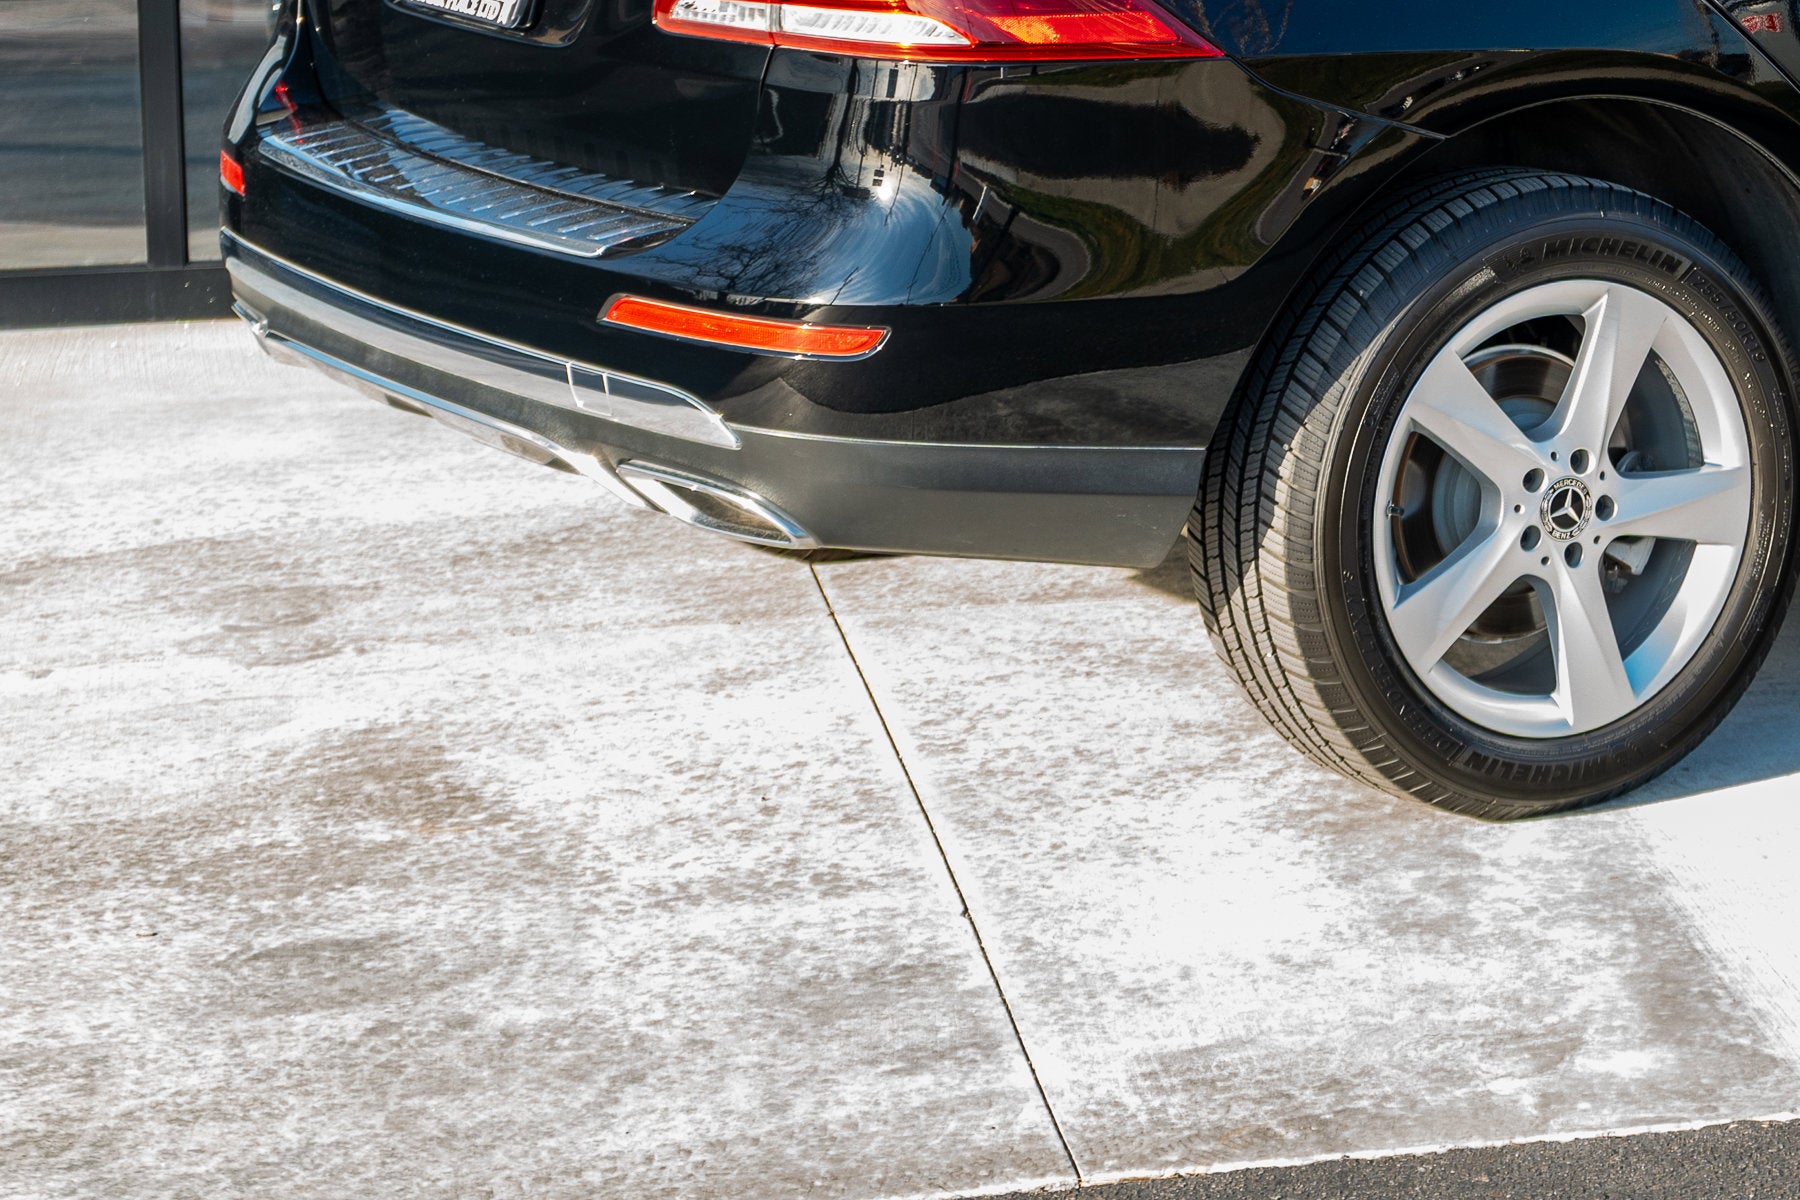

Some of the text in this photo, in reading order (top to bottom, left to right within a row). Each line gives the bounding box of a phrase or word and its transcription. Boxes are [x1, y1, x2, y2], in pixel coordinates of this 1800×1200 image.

[1541, 237, 1683, 277] MICHELIN
[1690, 275, 1766, 362] 255/50R19
[1462, 751, 1607, 784] MICHELIN
